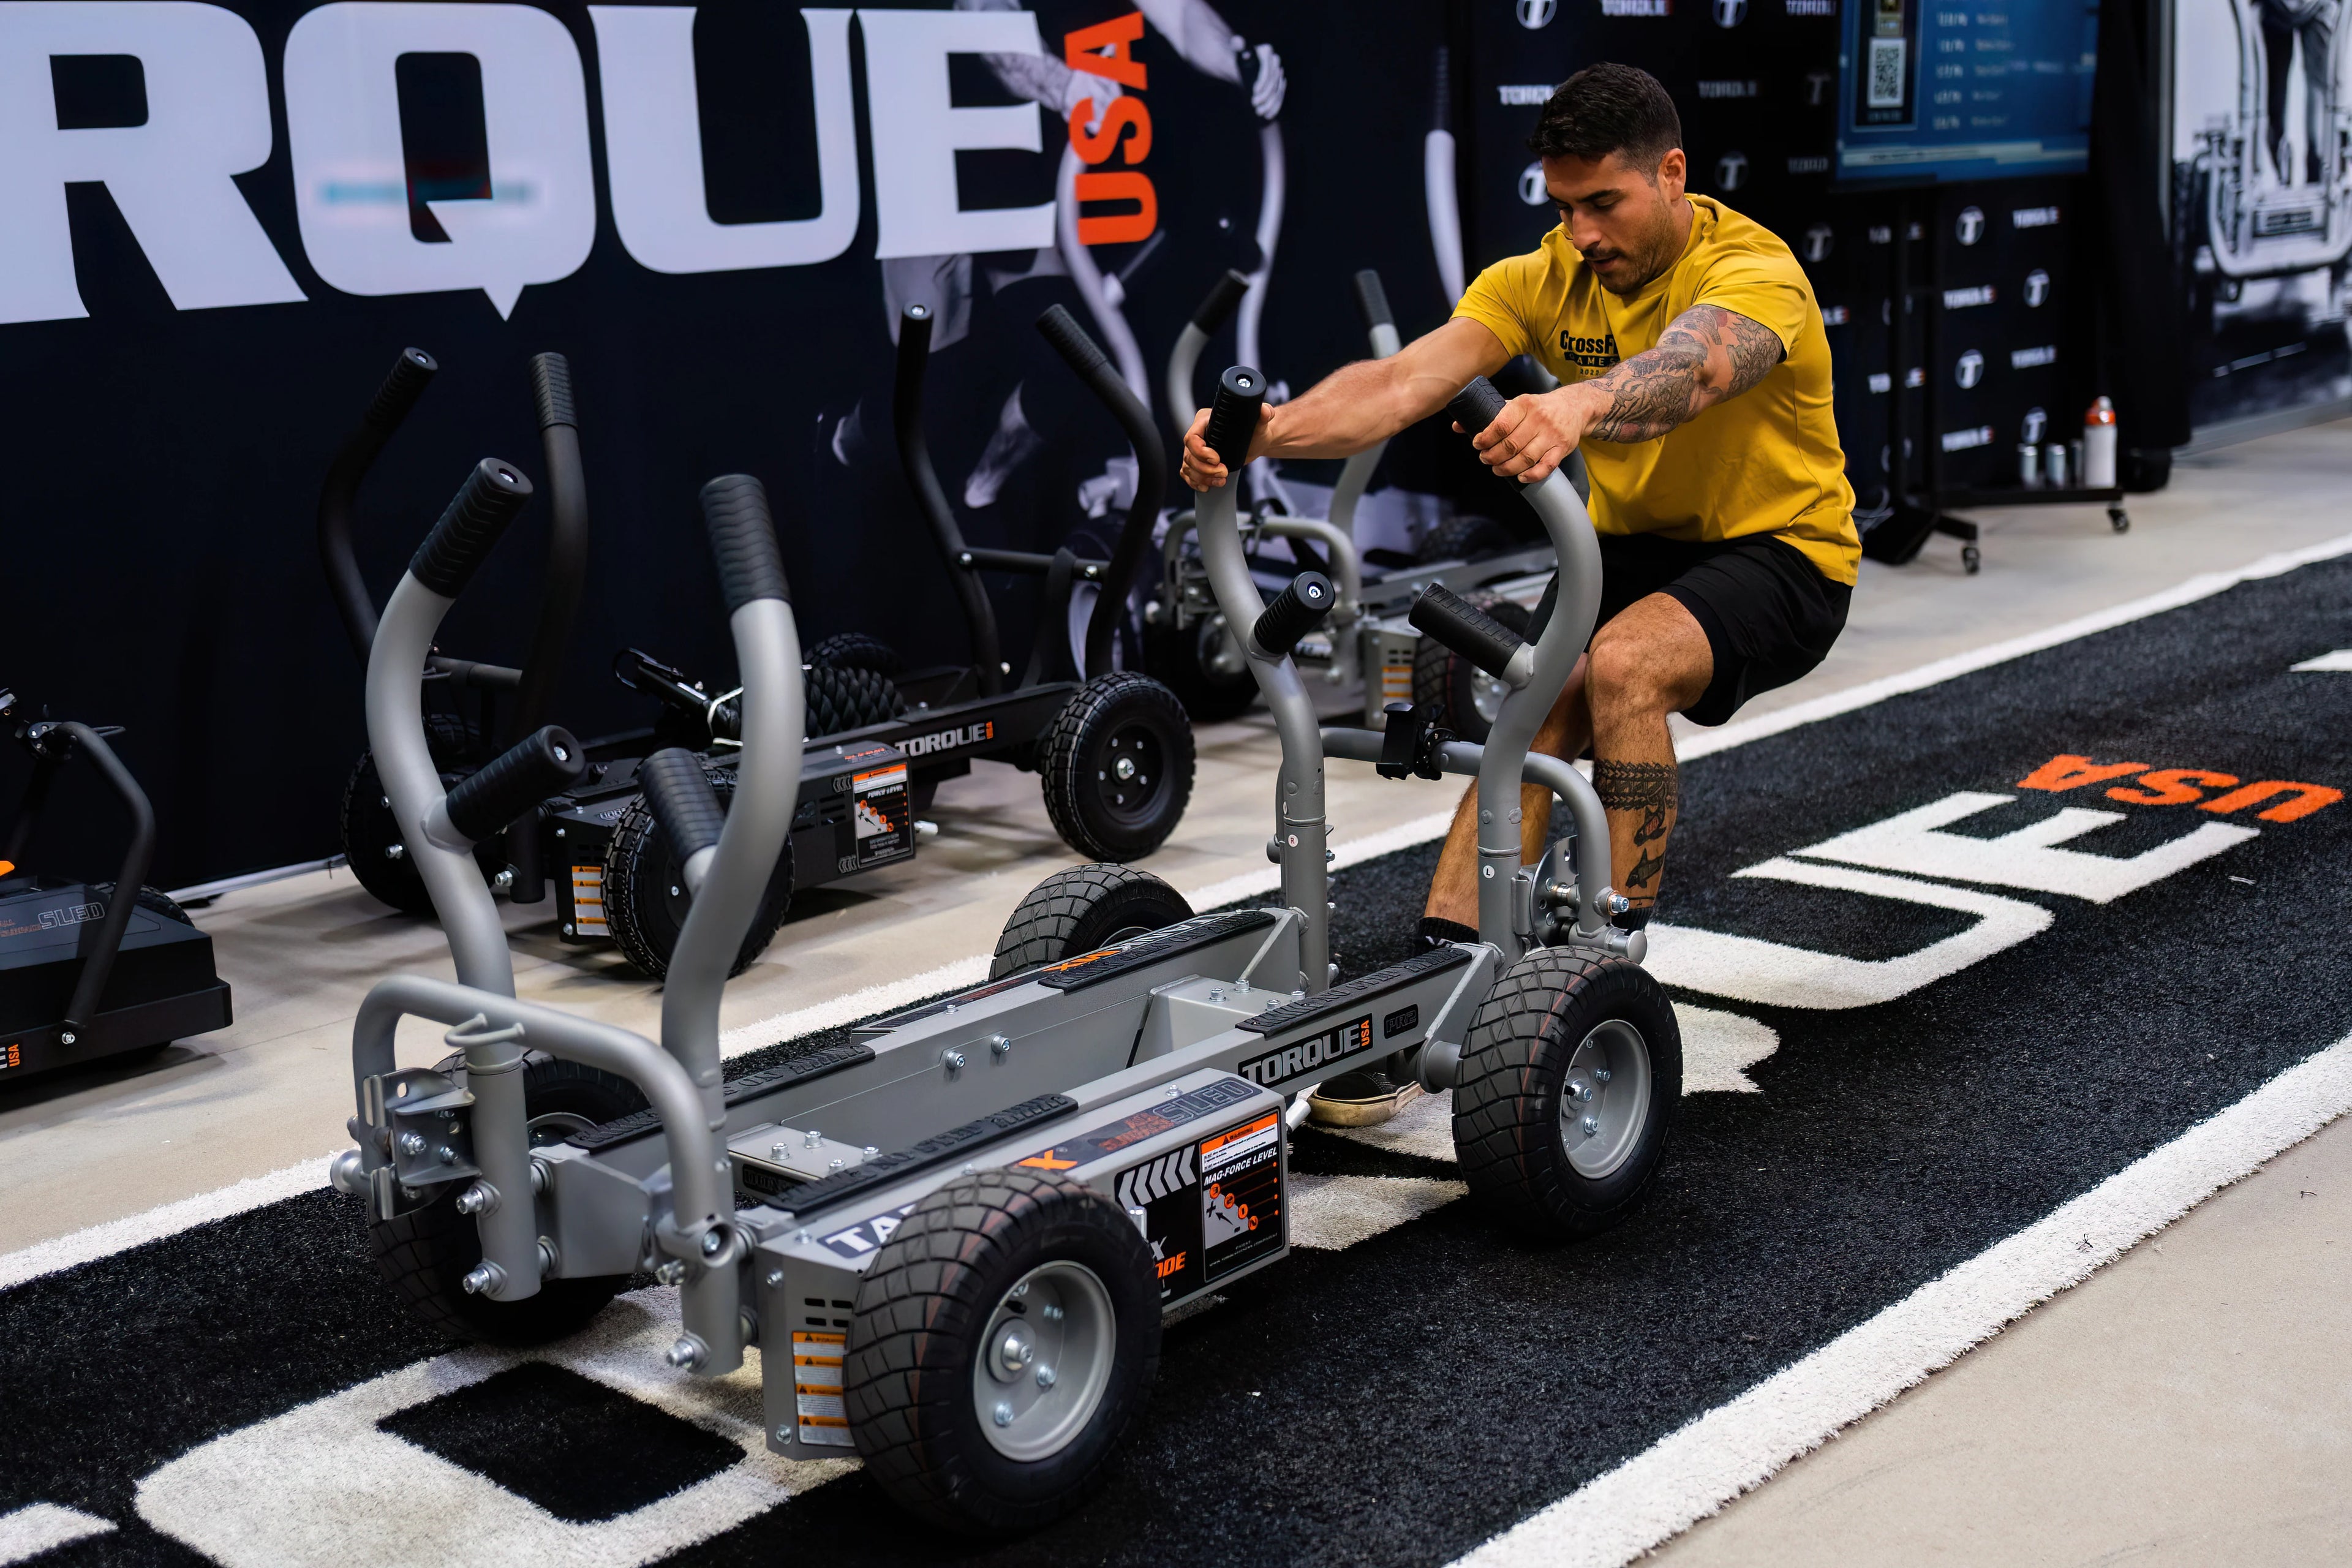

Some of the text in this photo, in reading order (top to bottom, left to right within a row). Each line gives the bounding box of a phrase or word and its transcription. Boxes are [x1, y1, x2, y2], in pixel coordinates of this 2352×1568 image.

[1065, 11, 1159, 247] USA
[894, 723, 986, 757] TORQUE
[2017, 753, 2345, 824] USA
[38, 902, 105, 930] SLED
[9, 1044, 20, 1067] USA
[1242, 1020, 1370, 1084] TORQUE USA
[1153, 1079, 1254, 1124] SLED
[1204, 1157, 1251, 1186] MAG-FORCE
[1252, 1146, 1278, 1165] LEVEL
[825, 1204, 917, 1253] TA
